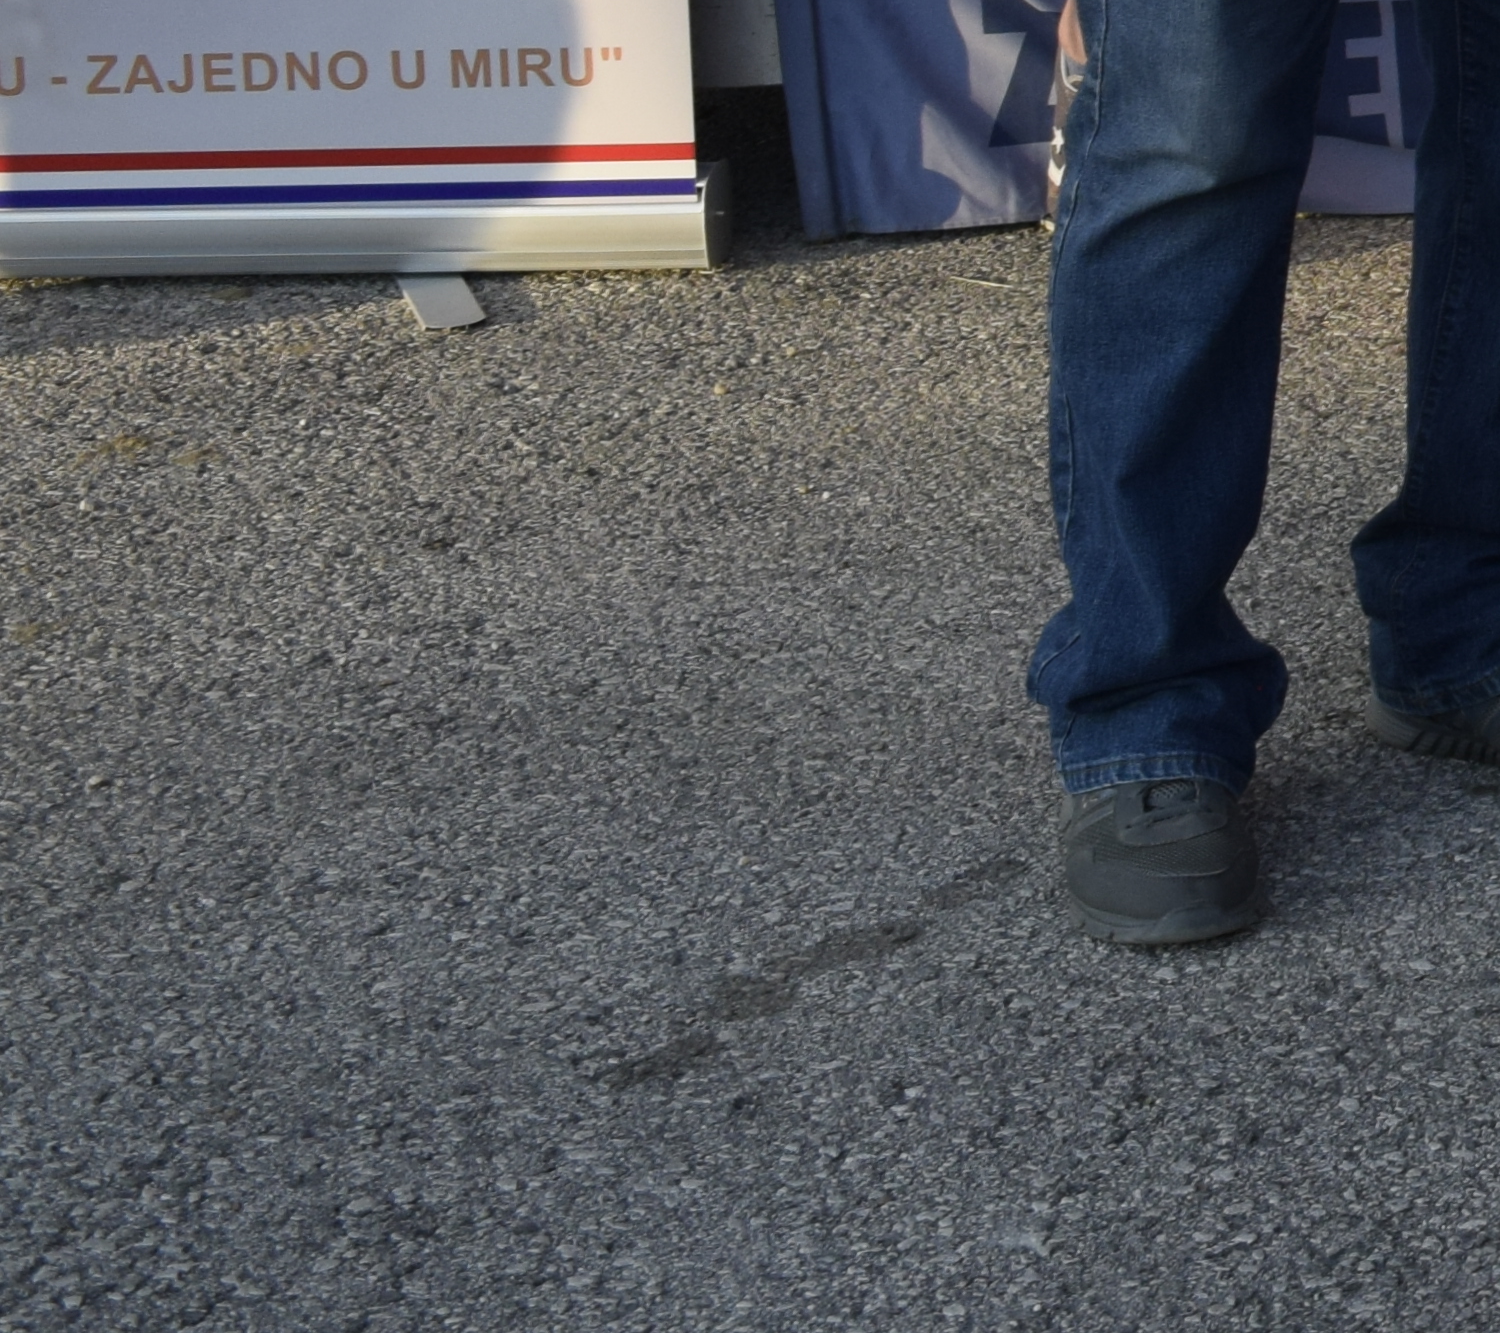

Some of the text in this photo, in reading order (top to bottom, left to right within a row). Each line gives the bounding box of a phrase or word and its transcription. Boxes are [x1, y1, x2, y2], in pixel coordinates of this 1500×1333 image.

[86, 49, 370, 95] ZAJEDNO
[390, 50, 427, 90] U
[449, 46, 624, 89] MIRU"
